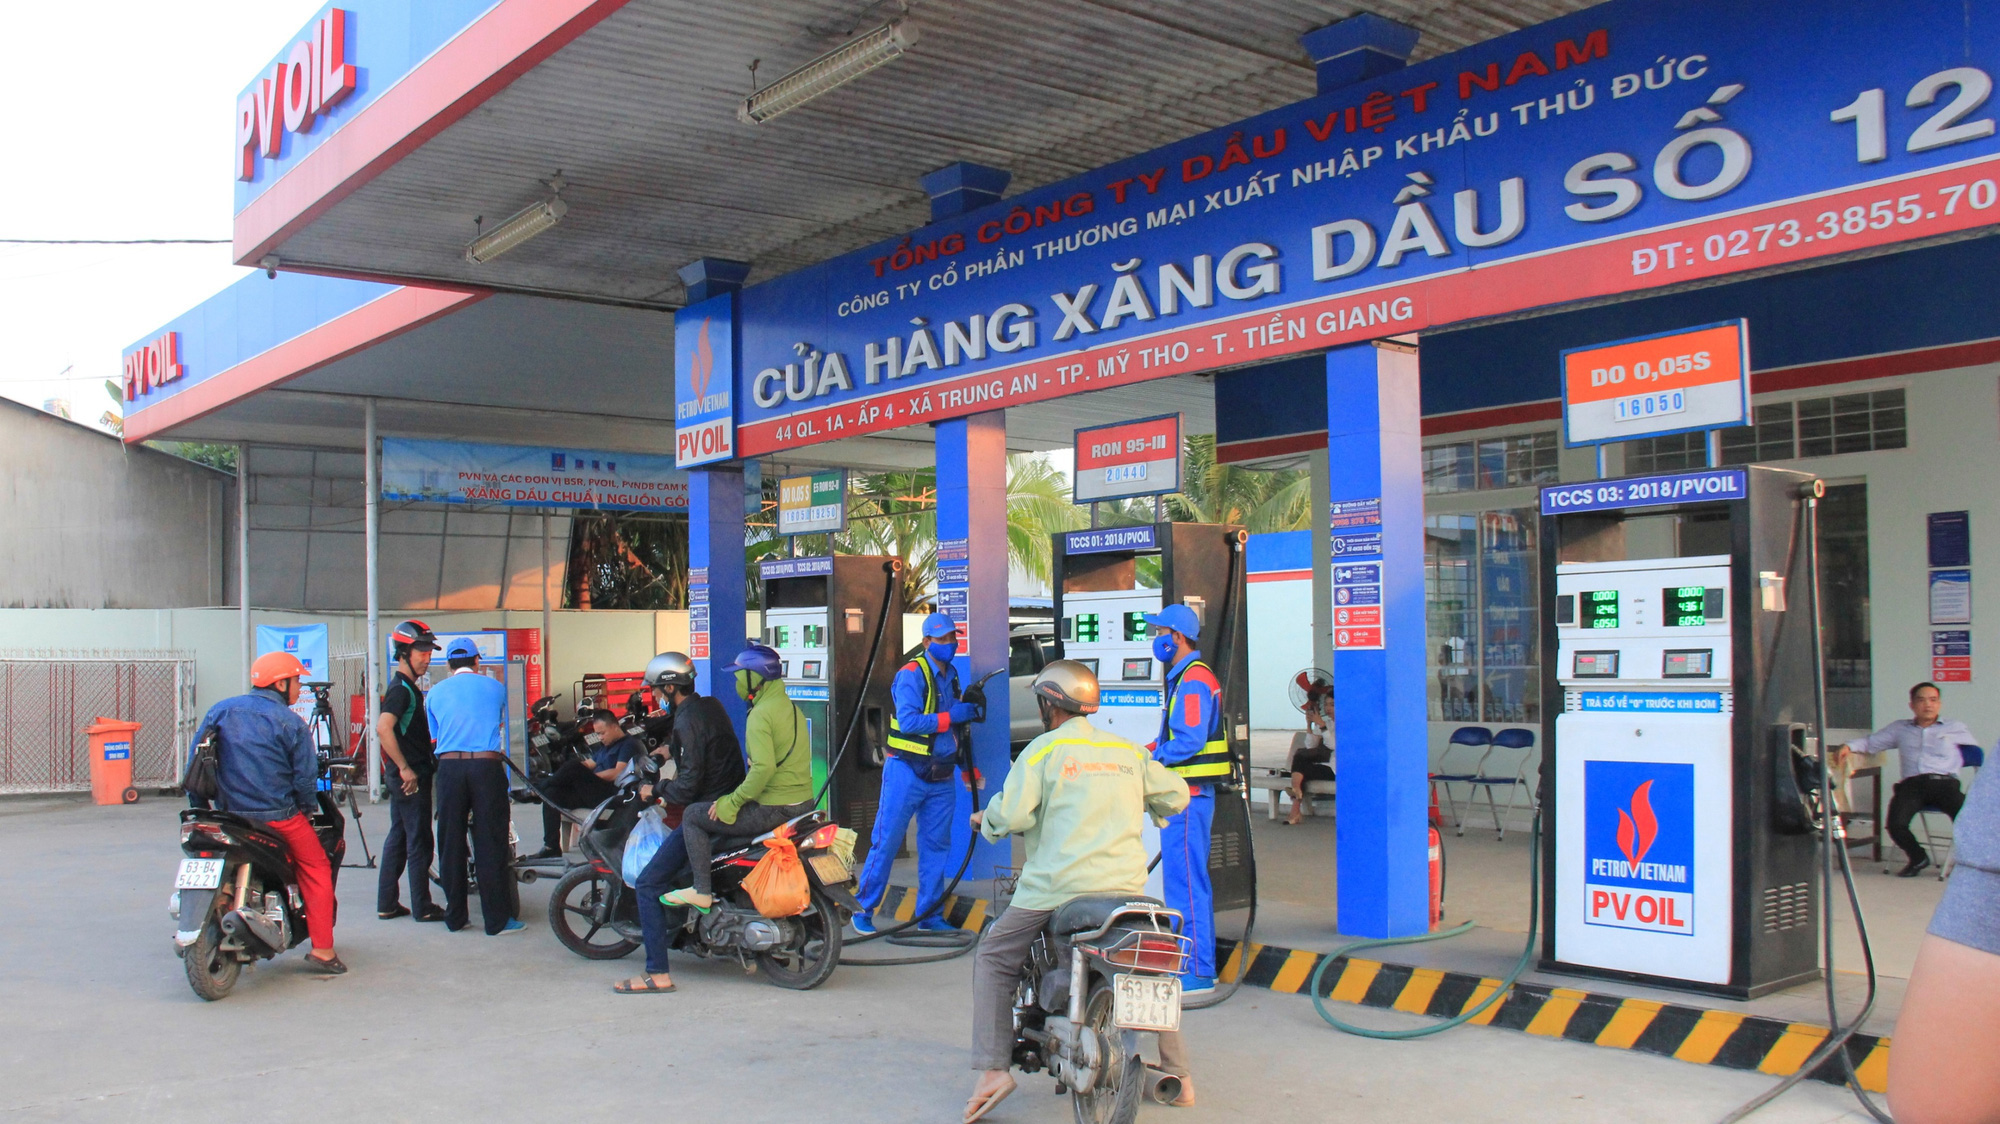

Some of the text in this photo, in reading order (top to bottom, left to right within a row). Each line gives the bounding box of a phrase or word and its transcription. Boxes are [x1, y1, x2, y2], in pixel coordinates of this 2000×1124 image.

[868, 28, 1609, 278] TỔNG CÔNG TY DẦU VIỆT NAM
[838, 54, 1708, 317] CÔNG TY CỔ PHẦN THƯƠNG MẠI XUẤT NHẬP KHẨU THỦ ĐỨC
[753, 66, 1996, 409] CỬA HÀNG XĂNG DẦU SỐ 12
[1631, 241, 1694, 277] ĐT:
[776, 424, 792, 442] 44
[796, 421, 821, 438] QL.
[826, 416, 845, 433] 1A
[858, 405, 881, 426] ẤP
[884, 402, 894, 420] 4
[909, 391, 933, 416] XÃ
[938, 380, 1004, 410] TRUNG
[1009, 372, 1037, 395] AN
[1056, 363, 1091, 388] TP.
[1097, 349, 1130, 378] MỸ
[1139, 341, 1190, 368] THO
[1212, 333, 1235, 355] T.
[1242, 313, 1306, 348] TIỀN
[1315, 296, 1413, 336] GIANG
[1591, 351, 1711, 387] DO 0,05S
[677, 391, 729, 421] PETROVIETNAM
[1618, 392, 1682, 418] 16050
[1091, 435, 1166, 458] RON 95-III
[458, 472, 481, 482] PVN
[483, 472, 499, 483] VÀ
[501, 473, 523, 484] CÁC
[525, 474, 550, 485] ĐƠN
[564, 478, 587, 488] BSR,
[588, 479, 619, 489] PVOIL,
[622, 480, 655, 491] PVNDB
[657, 482, 678, 492] CAM
[1107, 465, 1145, 482] 20440
[515, 487, 548, 502] DẦU
[551, 488, 603, 504] CHUẨN
[1549, 475, 1737, 508] TCCS 03: 2018/PVOIL
[1070, 530, 1150, 549] TCCS 01: 2018/PVOIL
[1585, 696, 1601, 708] TRẢ
[1602, 696, 1615, 708] SỐ
[1677, 699, 1693, 709] KHI
[1694, 698, 1717, 709] BƠM
[186, 861, 216, 874] 63-B4
[1592, 858, 1687, 883] PETROVIETNAM
[179, 874, 218, 888] 542.21
